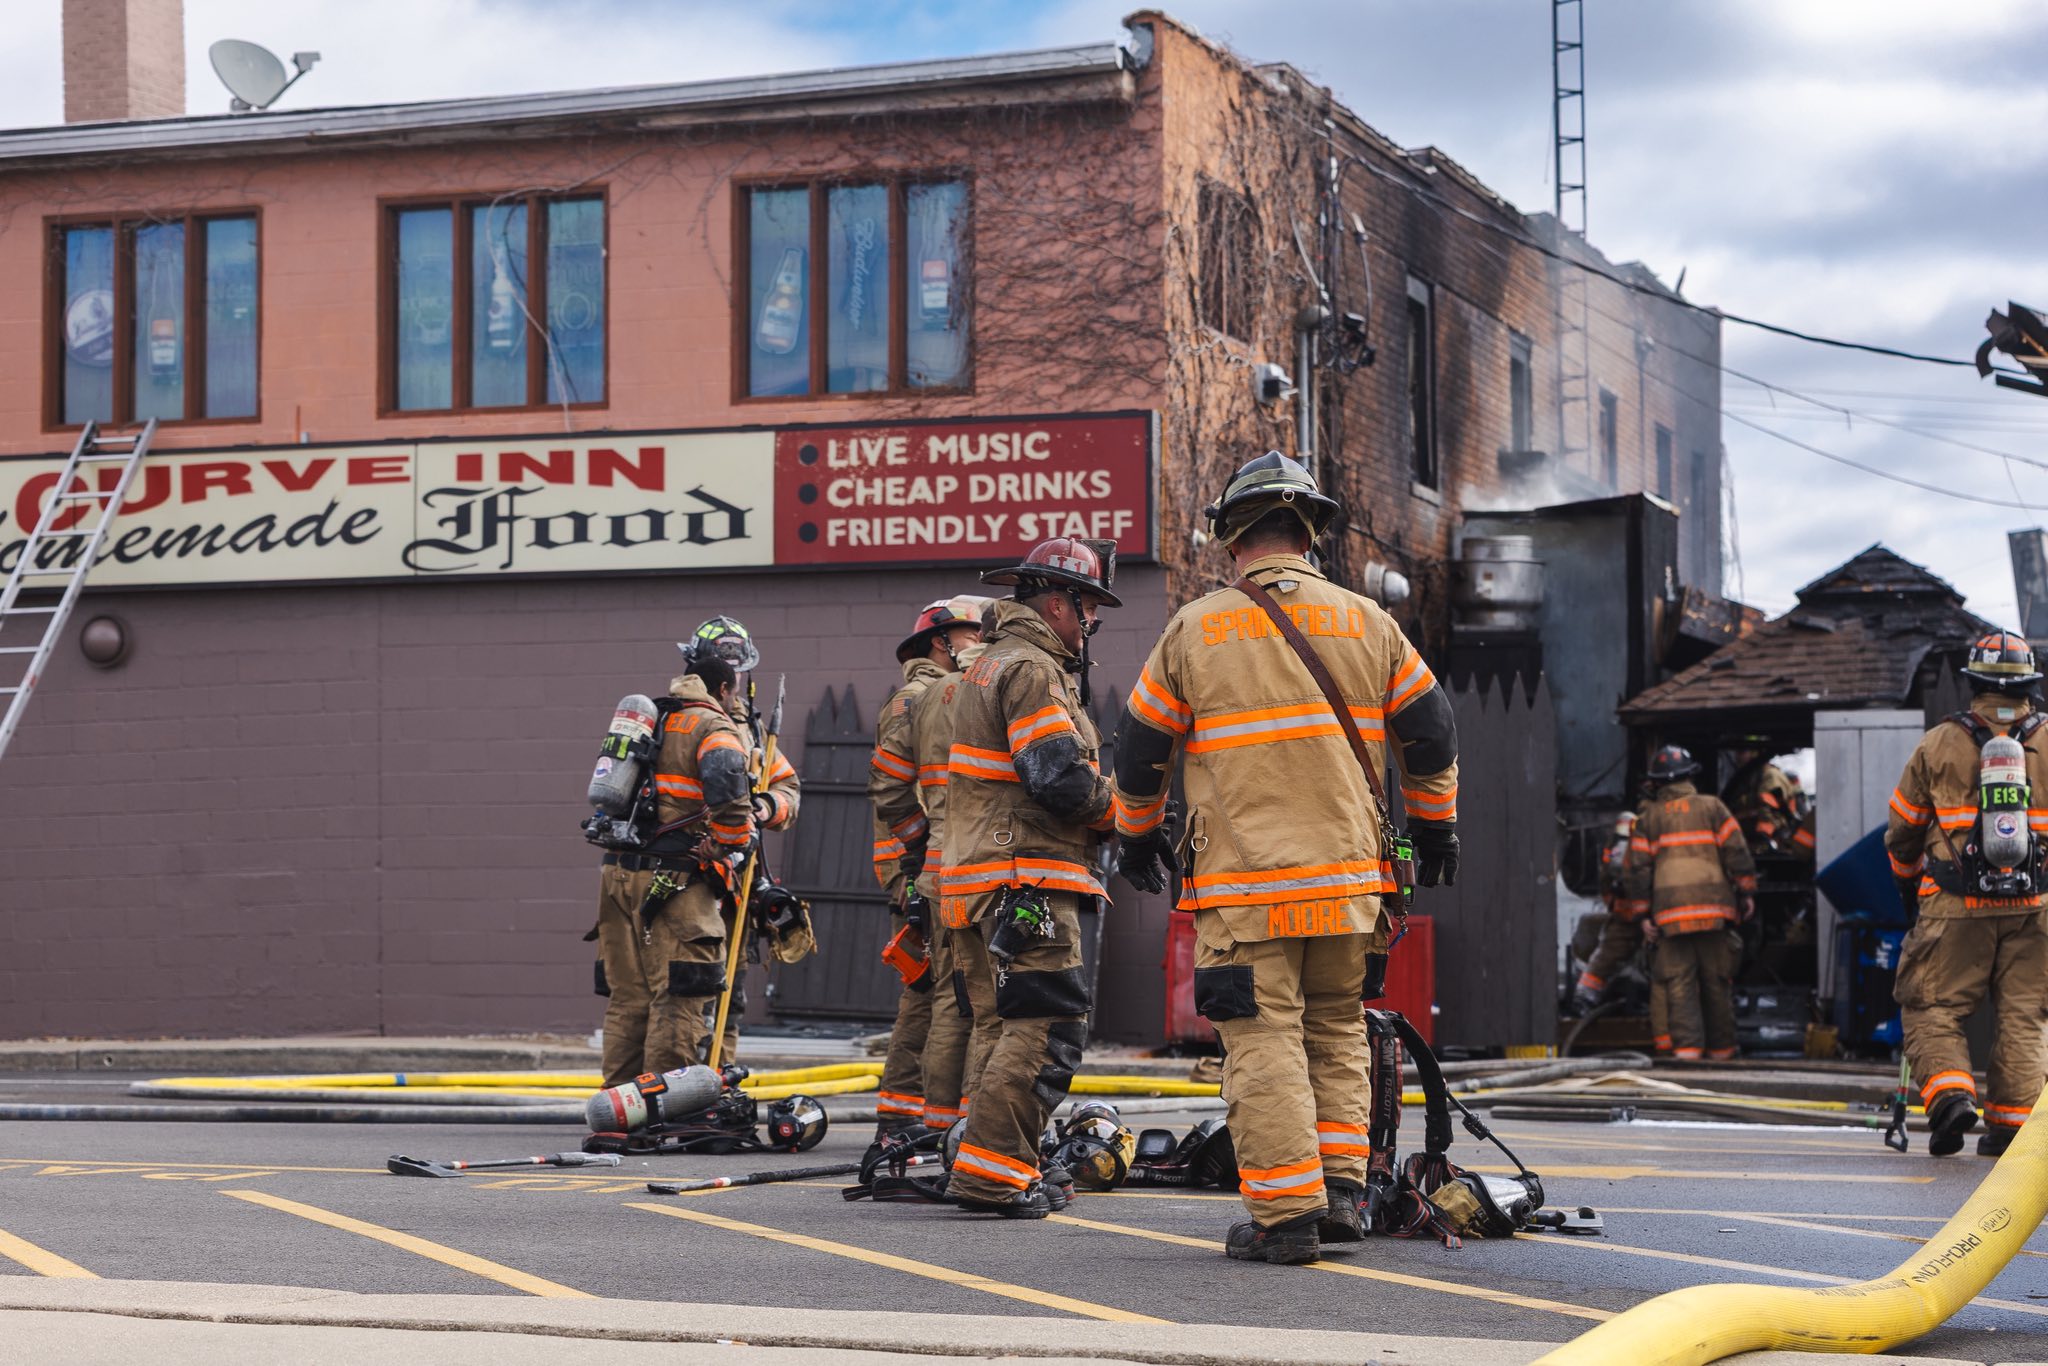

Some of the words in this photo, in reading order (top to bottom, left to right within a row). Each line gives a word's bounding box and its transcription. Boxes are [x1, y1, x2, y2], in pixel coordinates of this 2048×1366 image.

[827, 437, 907, 468] LIVE
[929, 432, 1050, 464] MUSIC
[15, 457, 411, 536] CURVE
[455, 447, 666, 492] INN
[827, 475, 958, 508] CHEAP
[969, 470, 1112, 503] DRINKS
[0, 497, 382, 573] omemade
[401, 482, 753, 571] Food
[827, 514, 1006, 547] FRIENDLY
[1018, 510, 1133, 541] STAFF
[1993, 787, 2019, 805] E13
[1268, 899, 1353, 938] MOORE
[1381, 1038, 1394, 1065] 3M
[1382, 1086, 1393, 1120] SCOTT
